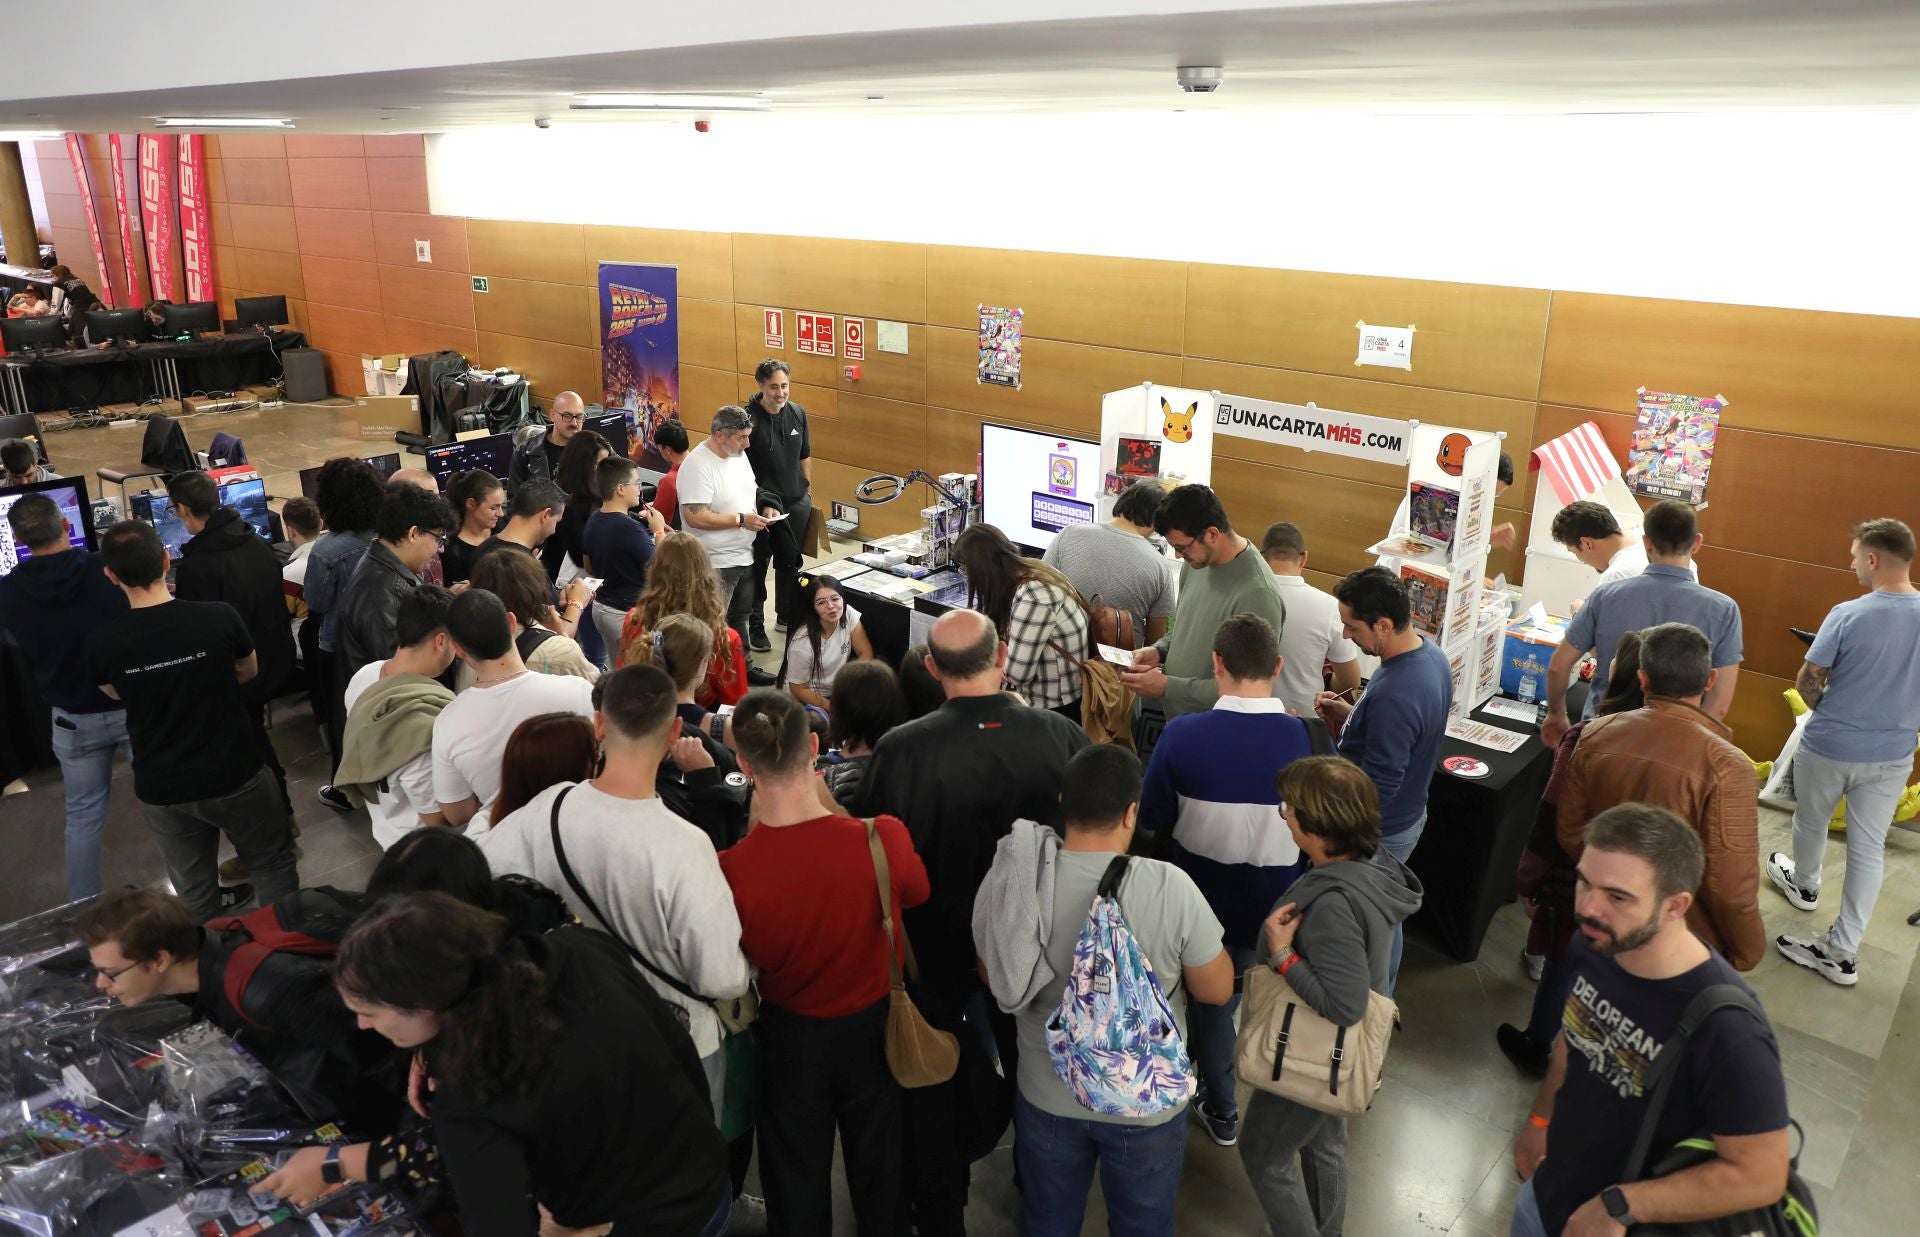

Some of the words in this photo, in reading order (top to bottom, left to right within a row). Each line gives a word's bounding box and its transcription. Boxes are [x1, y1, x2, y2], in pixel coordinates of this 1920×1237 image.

[178, 132, 201, 301] SOLISS
[609, 287, 650, 305] RETRO
[611, 303, 668, 320] BARCELONA
[1397, 339, 1405, 349] 4
[1232, 408, 1402, 451] UNACARTAMÁS.COM
[125, 651, 207, 674] WWW.GAMEMUSEUM.ES
[1572, 975, 1664, 1061] DELOREAN
